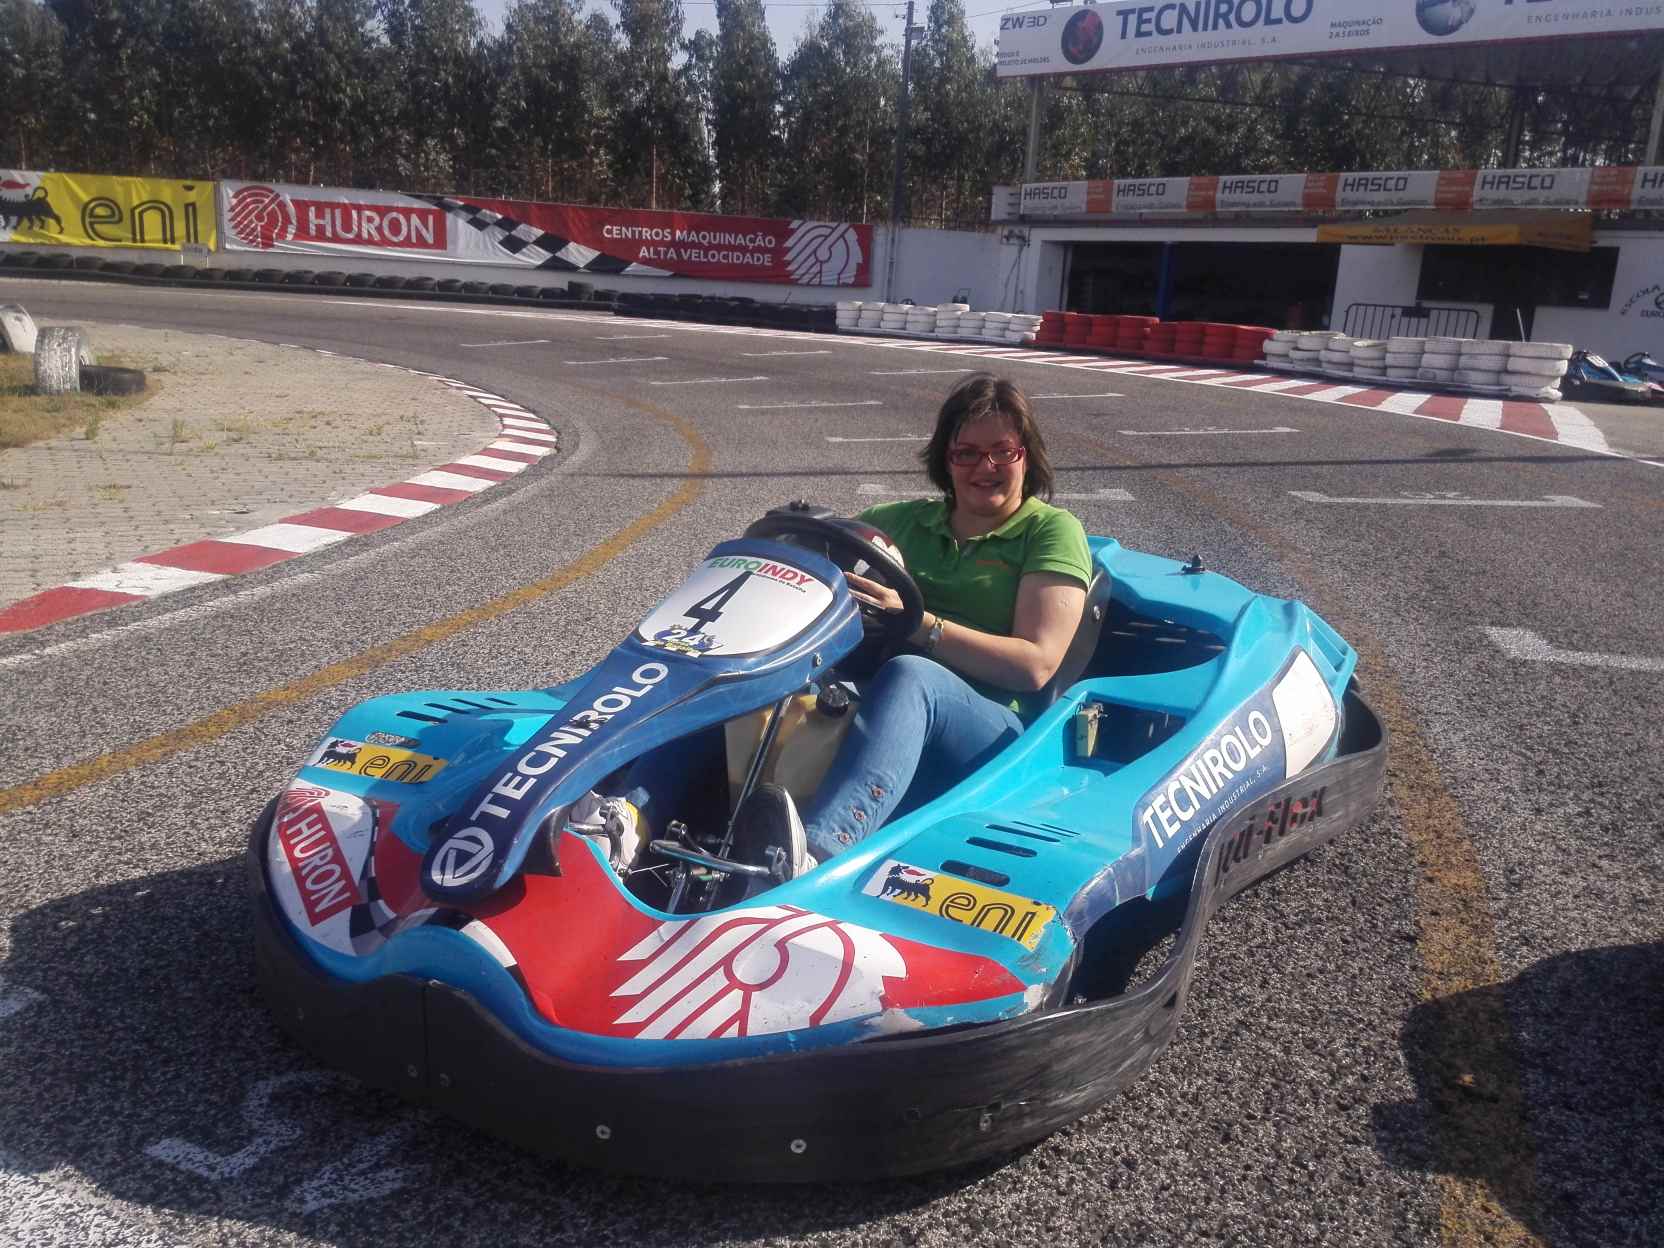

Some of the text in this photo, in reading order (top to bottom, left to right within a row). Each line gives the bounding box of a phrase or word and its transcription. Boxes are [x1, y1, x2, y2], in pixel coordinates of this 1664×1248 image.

[1000, 15, 1048, 30] ZW3D
[1116, 0, 1314, 40] TECNIROLO
[1526, 10, 1612, 24] ENGENHARIA
[1023, 186, 1068, 200] HASCO
[1116, 183, 1167, 197] HASCO
[1221, 179, 1279, 195] HASCO
[1342, 176, 1409, 192] HASCO
[1481, 174, 1555, 191] HASCO
[81, 184, 199, 245] eni
[307, 205, 435, 245] HURON
[602, 225, 776, 249] CENTROS MAQUINAÇÃO
[638, 245, 773, 266] ALTA VELOCIDADE
[709, 555, 817, 586] EUROINDY
[683, 570, 754, 634] 4
[470, 662, 669, 821] TECNIROLO
[359, 755, 441, 784] eni
[1141, 710, 1272, 849] TECNIROLO
[286, 813, 350, 914] HURON
[939, 892, 1043, 942] eni
